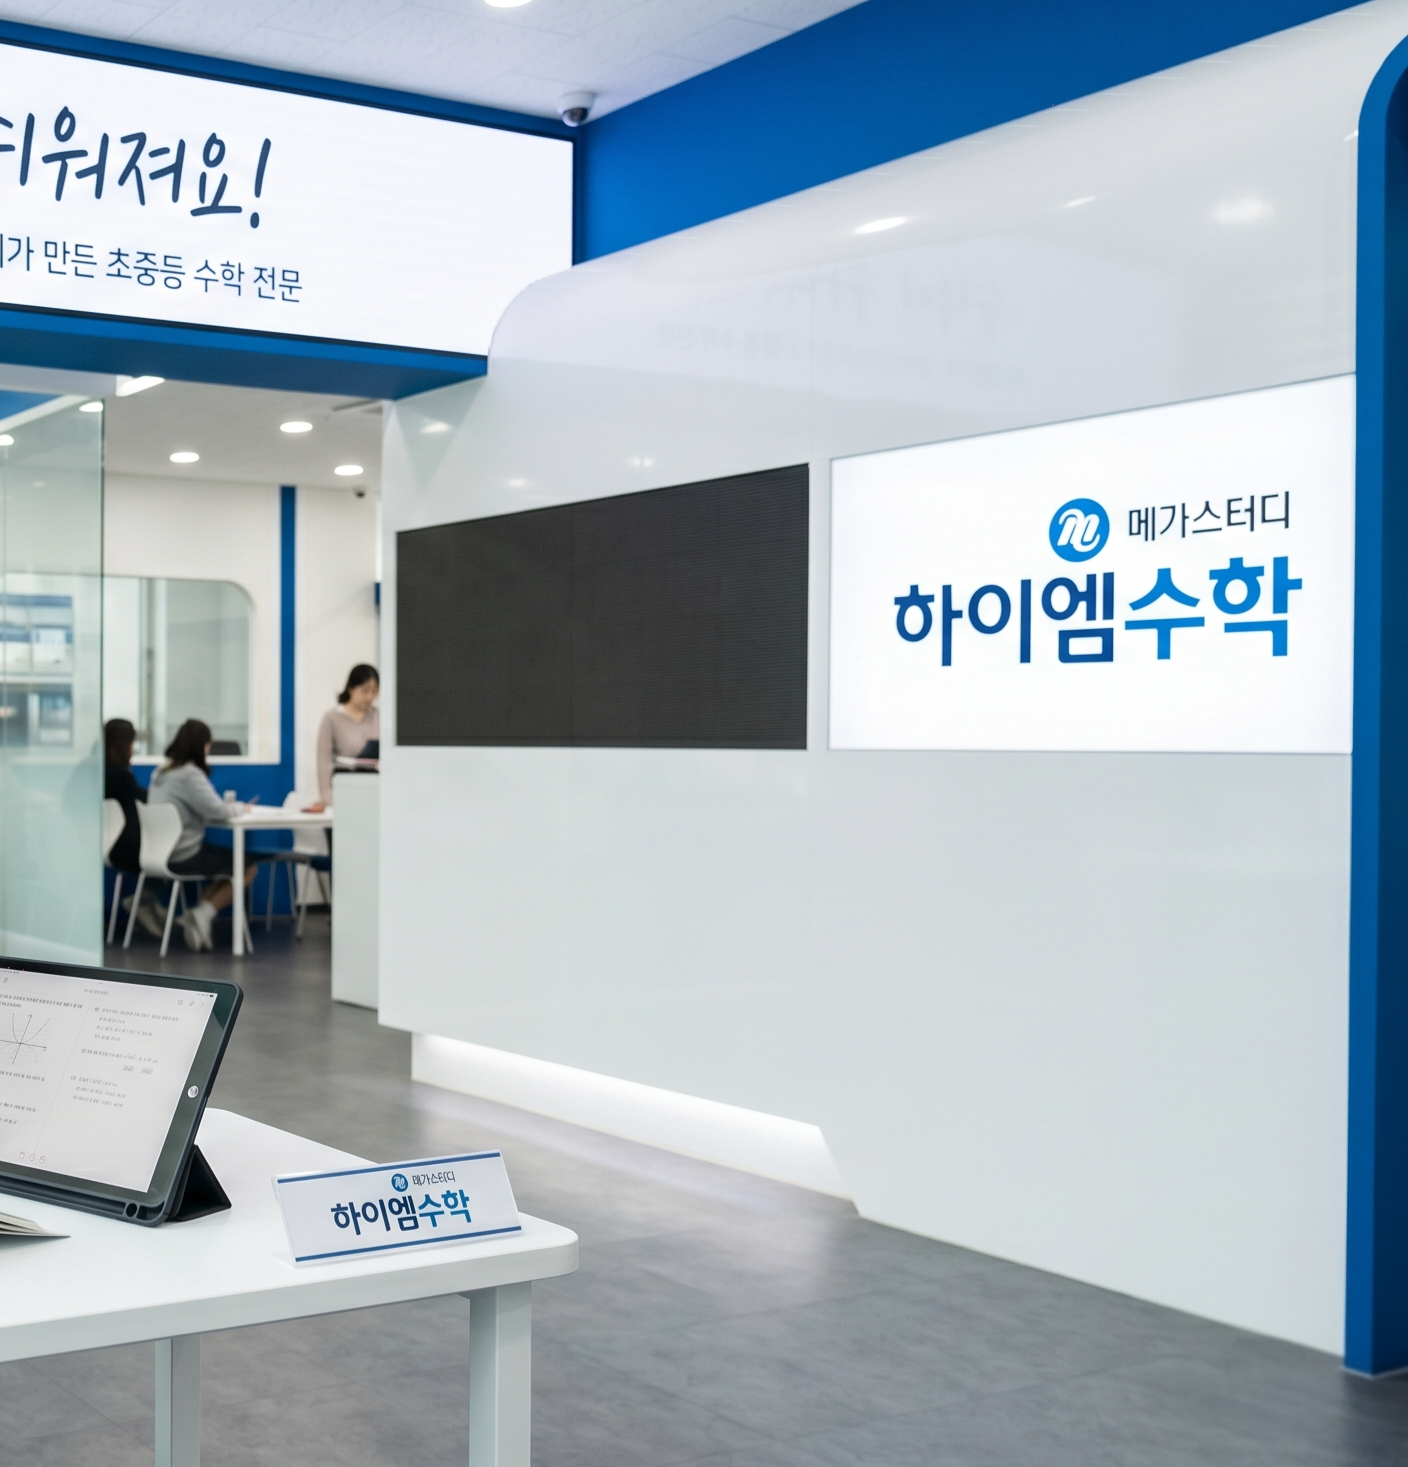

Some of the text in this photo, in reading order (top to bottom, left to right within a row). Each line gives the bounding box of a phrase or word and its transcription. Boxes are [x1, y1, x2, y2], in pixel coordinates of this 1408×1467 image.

[45, 241, 97, 278] 만든
[106, 248, 186, 290] 초중등
[194, 260, 245, 297] 수학
[254, 267, 303, 303] 전문
[1129, 491, 1290, 542] 메가스터디
[894, 556, 1302, 666] 하이엠수학
[331, 1189, 472, 1236] 하이엠수학
